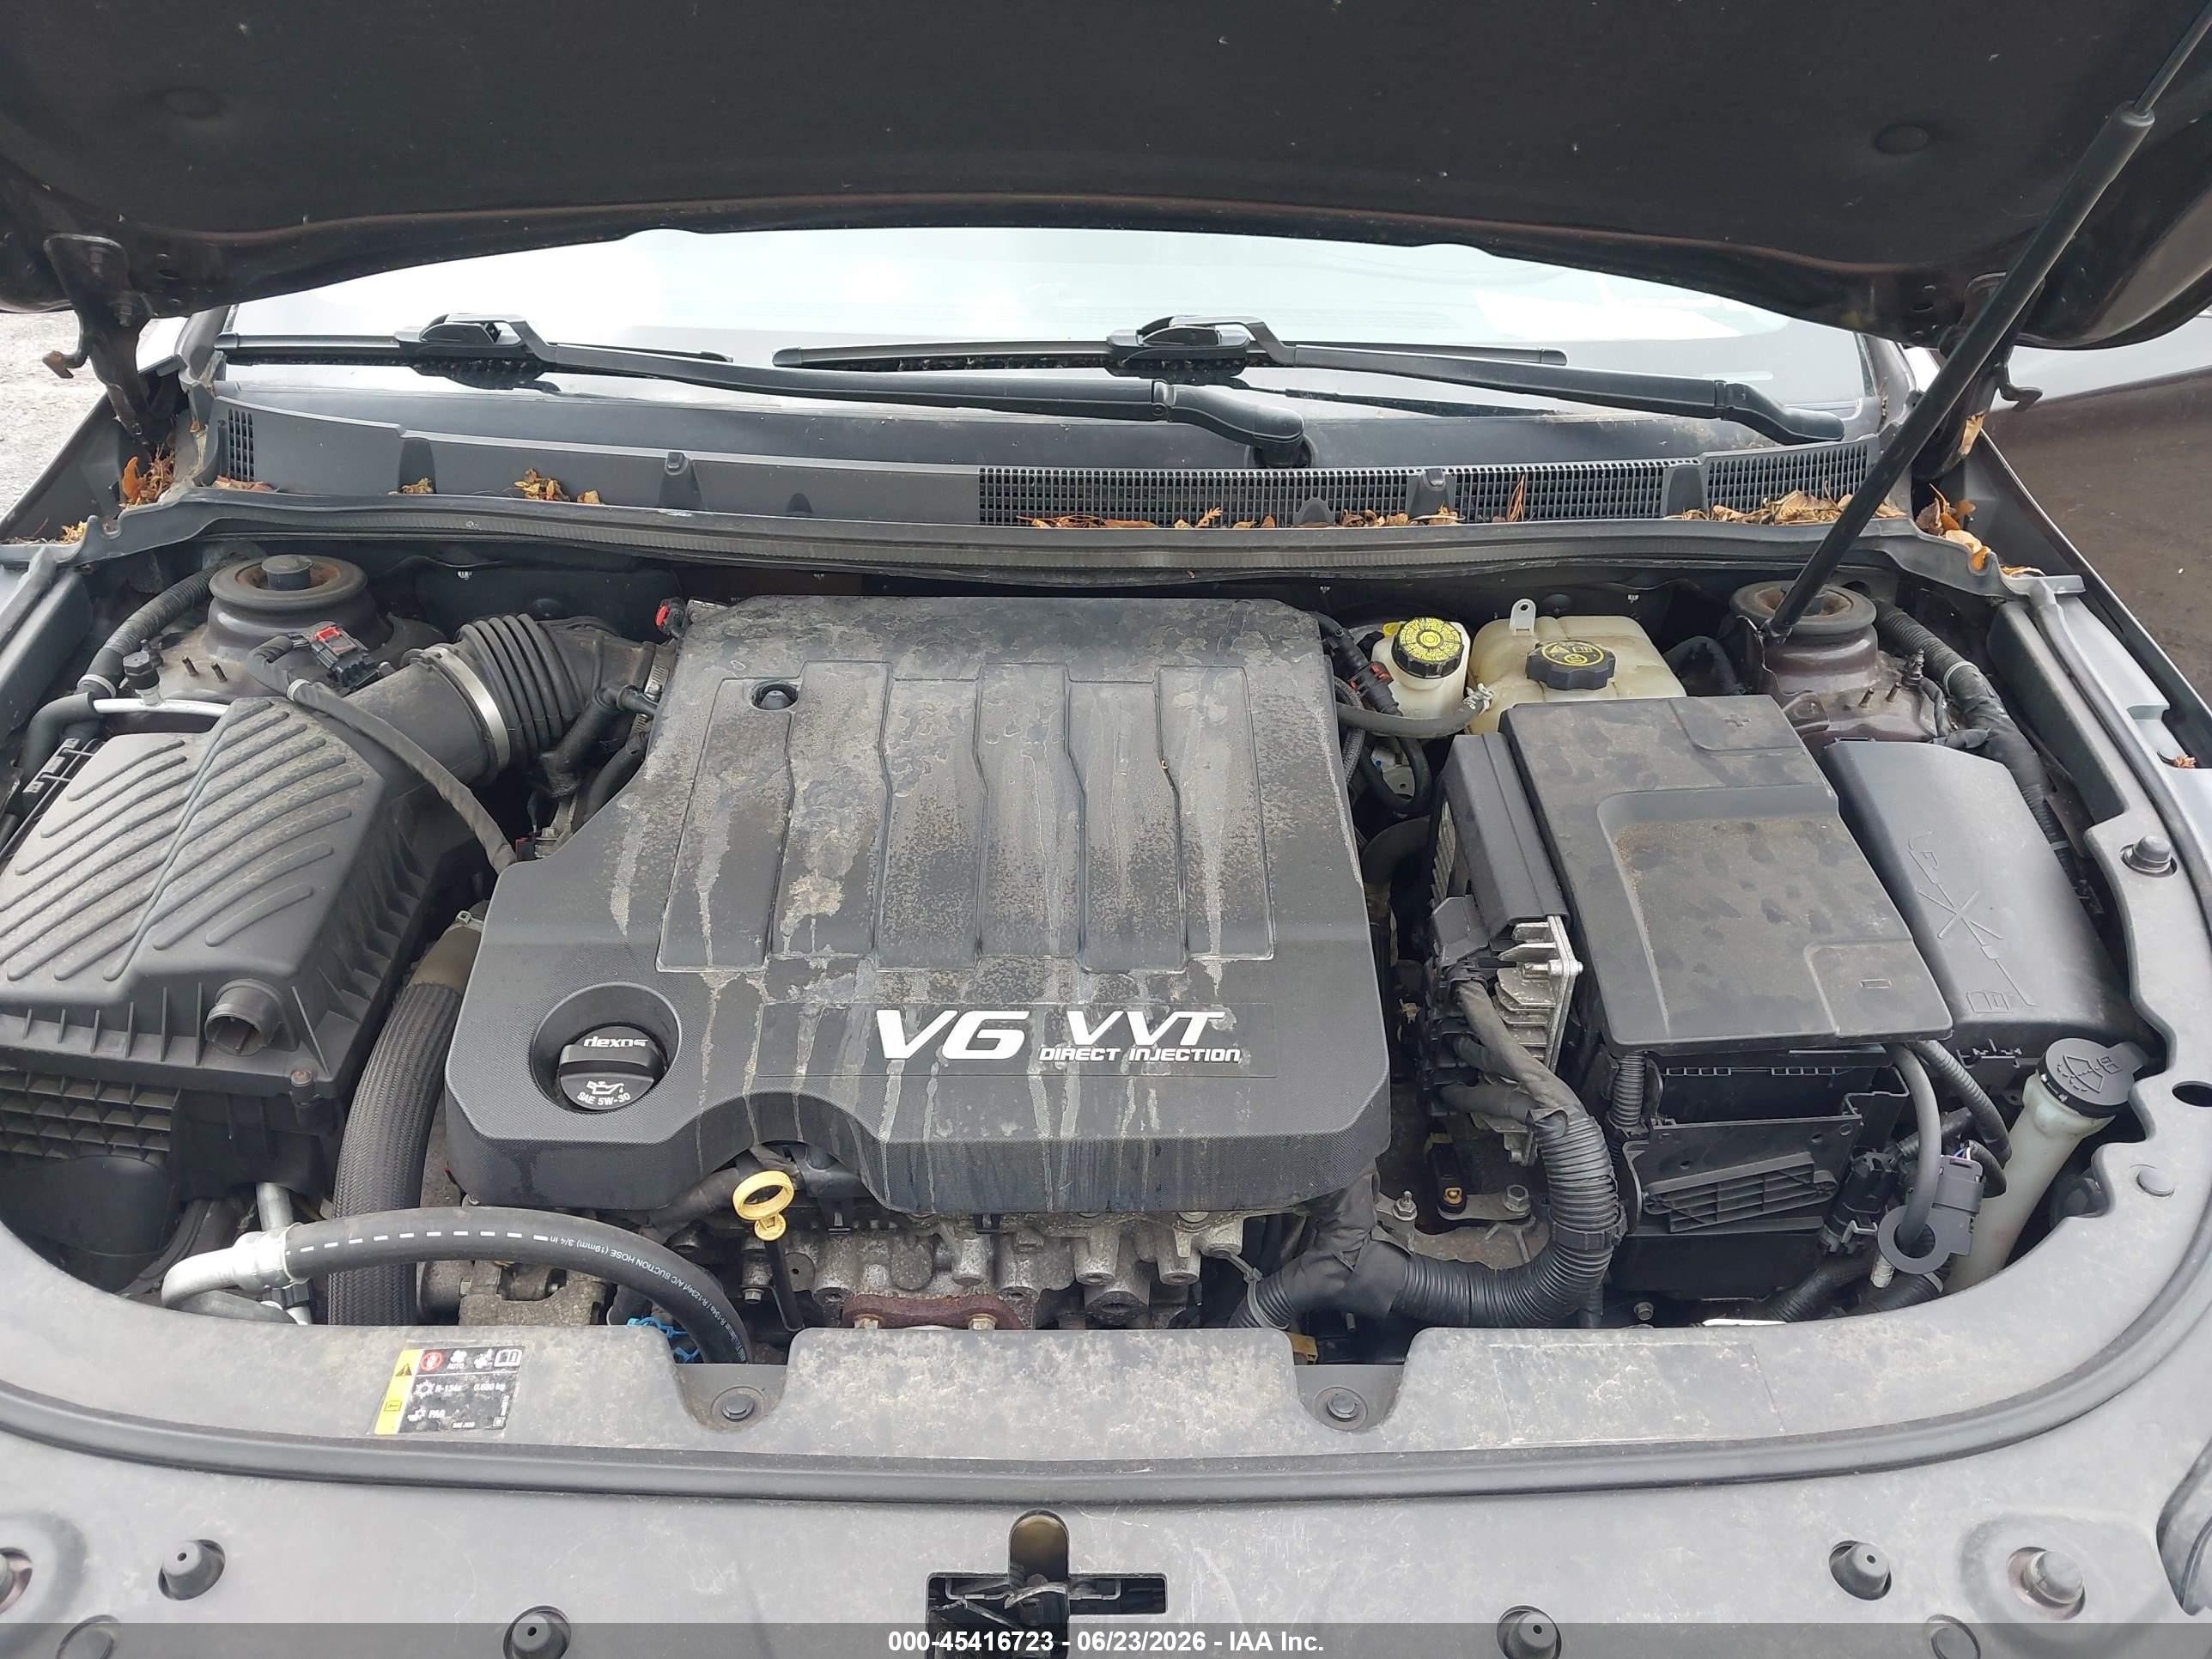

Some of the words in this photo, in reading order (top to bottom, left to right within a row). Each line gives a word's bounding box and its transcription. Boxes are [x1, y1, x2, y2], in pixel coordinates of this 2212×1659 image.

[584, 1036, 648, 1046] dexos
[876, 1009, 1030, 1060] V6
[1066, 1010, 1225, 1046] VVT
[1039, 1047, 1121, 1062] DIRECT
[1128, 1047, 1242, 1062] INJECTION
[577, 1092, 596, 1104] SAE
[597, 1093, 630, 1105] 5W-30
[560, 1237, 575, 1247] 3/4
[576, 1239, 609, 1255] (19mm)
[610, 1249, 635, 1264] HOSE
[635, 1258, 672, 1280] SUCTION
[670, 1276, 686, 1288] A/C
